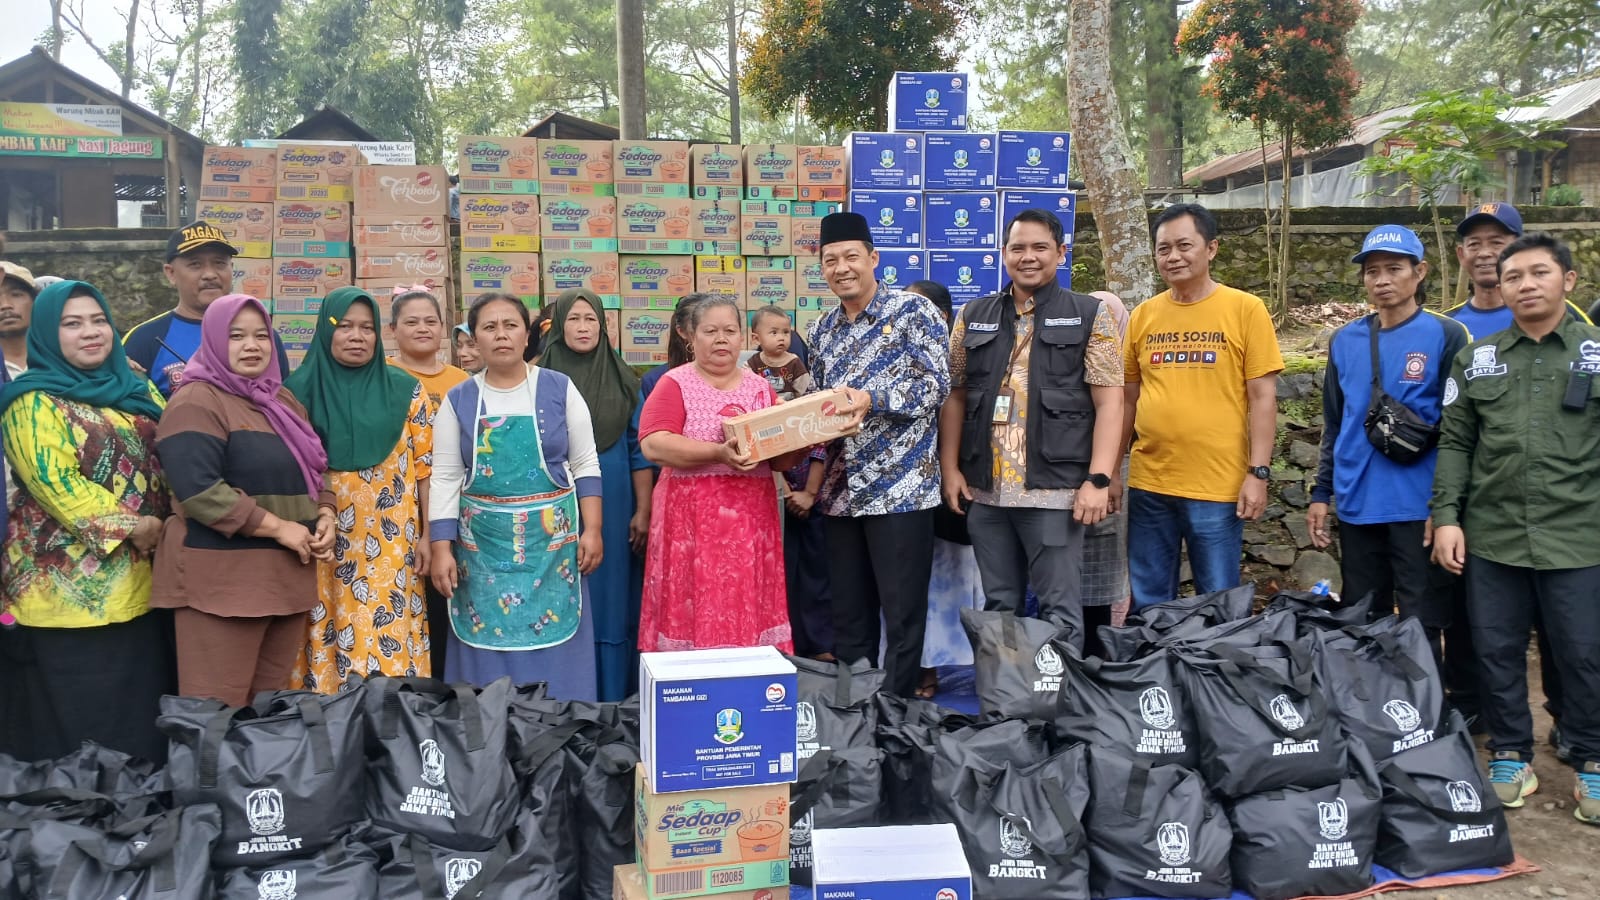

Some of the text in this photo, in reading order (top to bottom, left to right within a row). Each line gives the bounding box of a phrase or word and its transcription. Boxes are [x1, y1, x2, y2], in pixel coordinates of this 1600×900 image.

[77, 138, 105, 153] Nasi
[107, 139, 153, 155] Jagung
[464, 147, 509, 157] Sedaap
[543, 151, 587, 161] Sedaap
[618, 152, 662, 162] Sedaap
[282, 153, 325, 163] Sedaap
[464, 203, 509, 213] Sedaap
[544, 207, 589, 217] Sedaap
[200, 209, 243, 219] Sedaap
[277, 209, 321, 219] Sedaap
[622, 208, 666, 219] Sedaap
[1367, 232, 1402, 247] TAGANA
[277, 267, 322, 277] Sedaap
[466, 263, 511, 273] Sedaap
[547, 264, 592, 274] Sedaap
[625, 266, 668, 276] Sedaap
[279, 326, 315, 335] Sedaa
[625, 321, 669, 331] Sedaap
[1183, 331, 1227, 344] SOSIAL
[1152, 353, 1214, 362] HADIR
[1472, 367, 1495, 376] BAYU
[663, 687, 692, 695] MAKANAN
[1034, 680, 1060, 692] BANG
[663, 695, 695, 703] TAMBAHAN
[1143, 729, 1182, 738] BANTUAN
[1141, 737, 1183, 746] GUBERNUR
[1392, 730, 1434, 753] BANGKIT
[695, 744, 761, 755] BANTUAN PEMERINTAH
[1136, 744, 1186, 754] JAWA TIMUR
[1272, 739, 1320, 756] BANGKIT
[725, 752, 741, 760] JAWA
[400, 802, 456, 819] JAWA TIMUR
[666, 804, 684, 812] Mie
[658, 808, 742, 831] Sedaap
[698, 827, 721, 836] Cup
[1449, 824, 1494, 842] BANGKIT
[237, 838, 303, 854] BANGKIT
[693, 845, 716, 853] Spesial
[1316, 842, 1352, 851] BANTUAN
[1314, 850, 1355, 859] GUBERNUR
[1308, 857, 1358, 869] JAWA TIMUR
[989, 864, 1046, 879] BANGKIT
[1144, 870, 1202, 883] BANGKIT
[712, 870, 743, 885] 1120085
